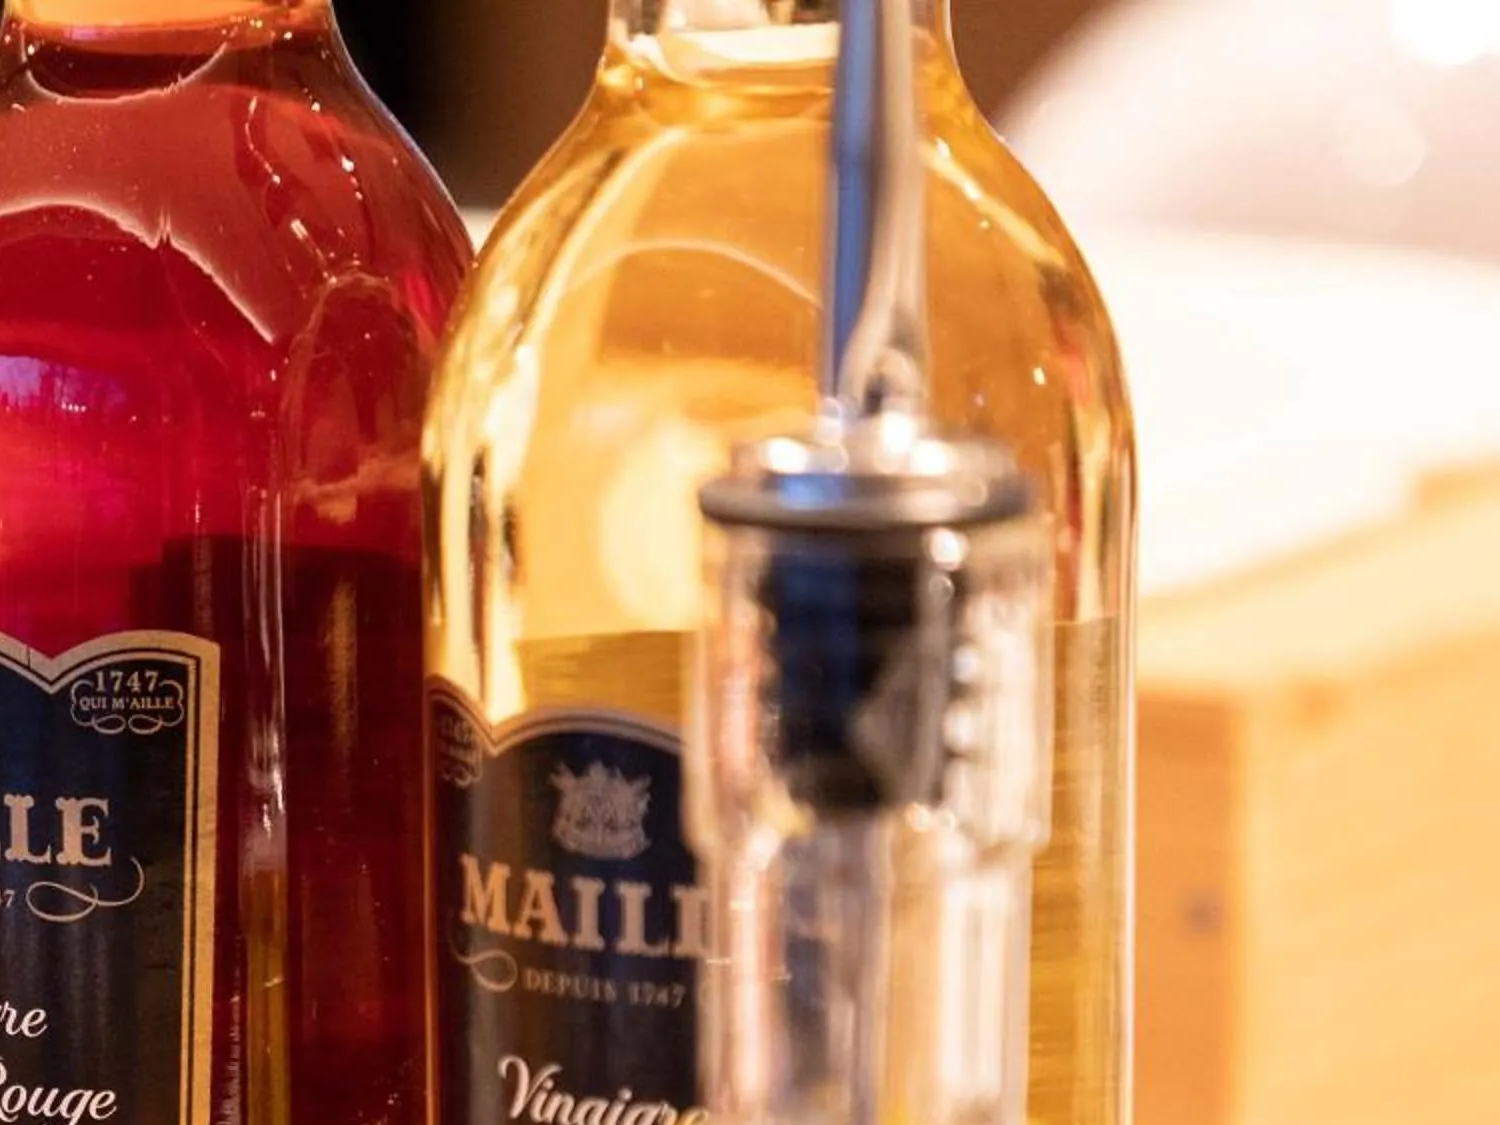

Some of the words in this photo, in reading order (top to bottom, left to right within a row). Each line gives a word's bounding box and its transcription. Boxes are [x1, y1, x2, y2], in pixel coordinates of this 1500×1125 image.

[95, 670, 159, 692] 1747
[80, 697, 106, 711] QUI
[111, 697, 175, 710] M'AILLE
